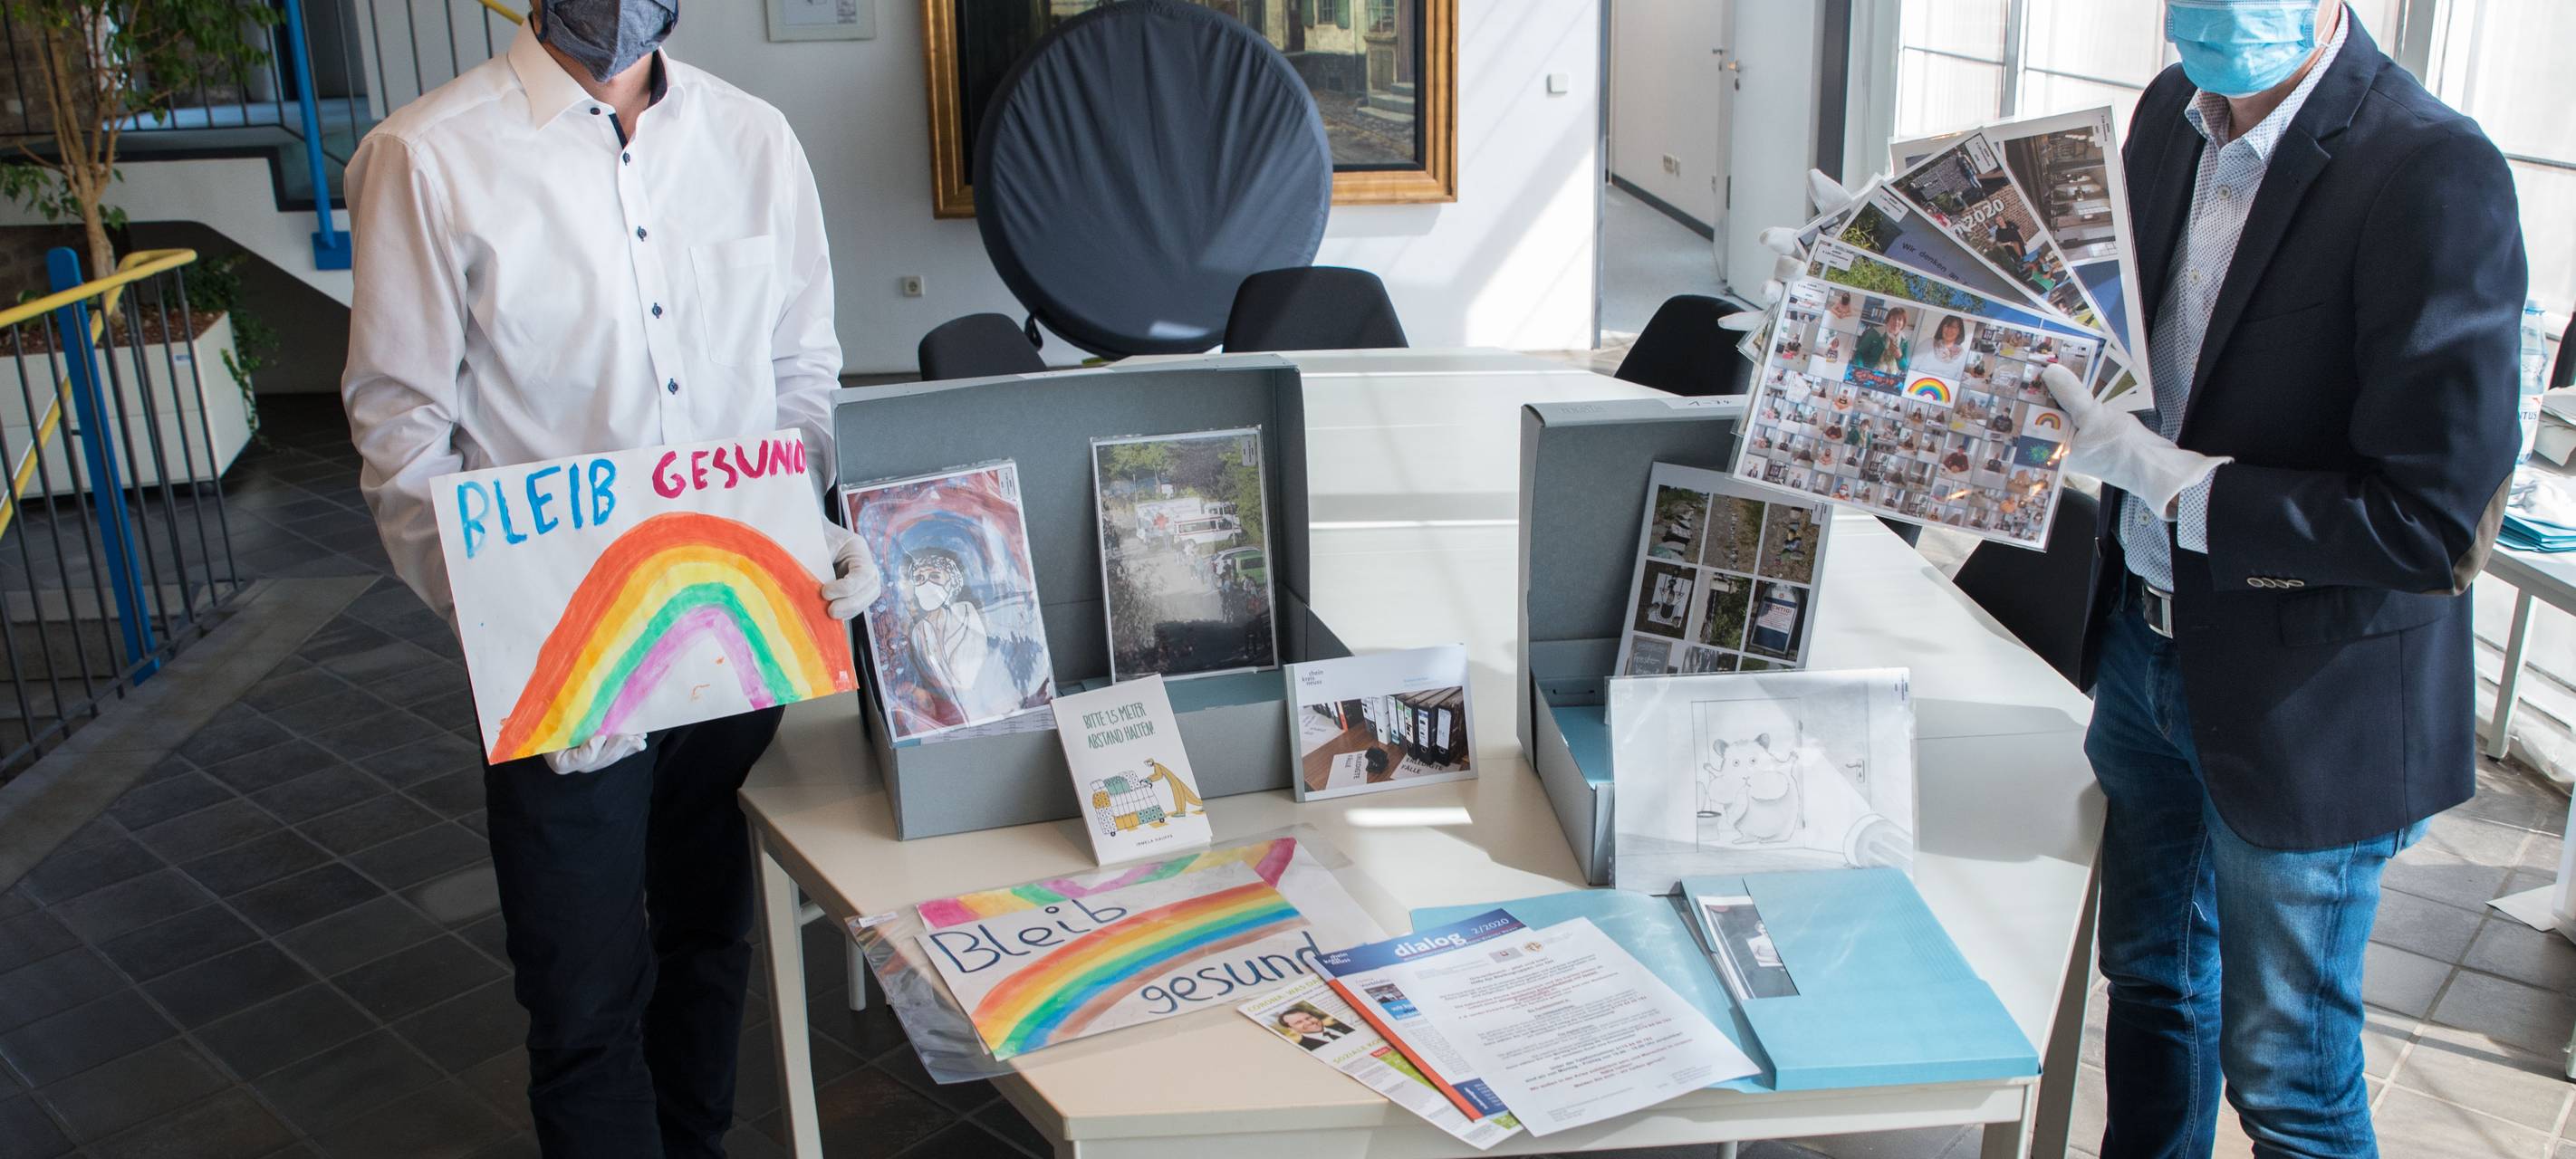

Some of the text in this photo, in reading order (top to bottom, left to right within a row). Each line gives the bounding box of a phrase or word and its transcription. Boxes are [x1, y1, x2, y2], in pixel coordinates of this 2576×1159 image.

[1901, 241, 1916, 255] Wir
[1918, 251, 1947, 273] denken
[457, 438, 809, 560] BLEIB GESUND
[1082, 712, 1106, 729] BITTE
[1120, 702, 1147, 722] METER
[1088, 721, 1156, 749] ABSTAND HALTEN!
[929, 899, 1127, 973] Bleib
[1394, 933, 1467, 958] dialog
[1471, 918, 1510, 935] 2/2020
[1140, 931, 1324, 1014] gesund
